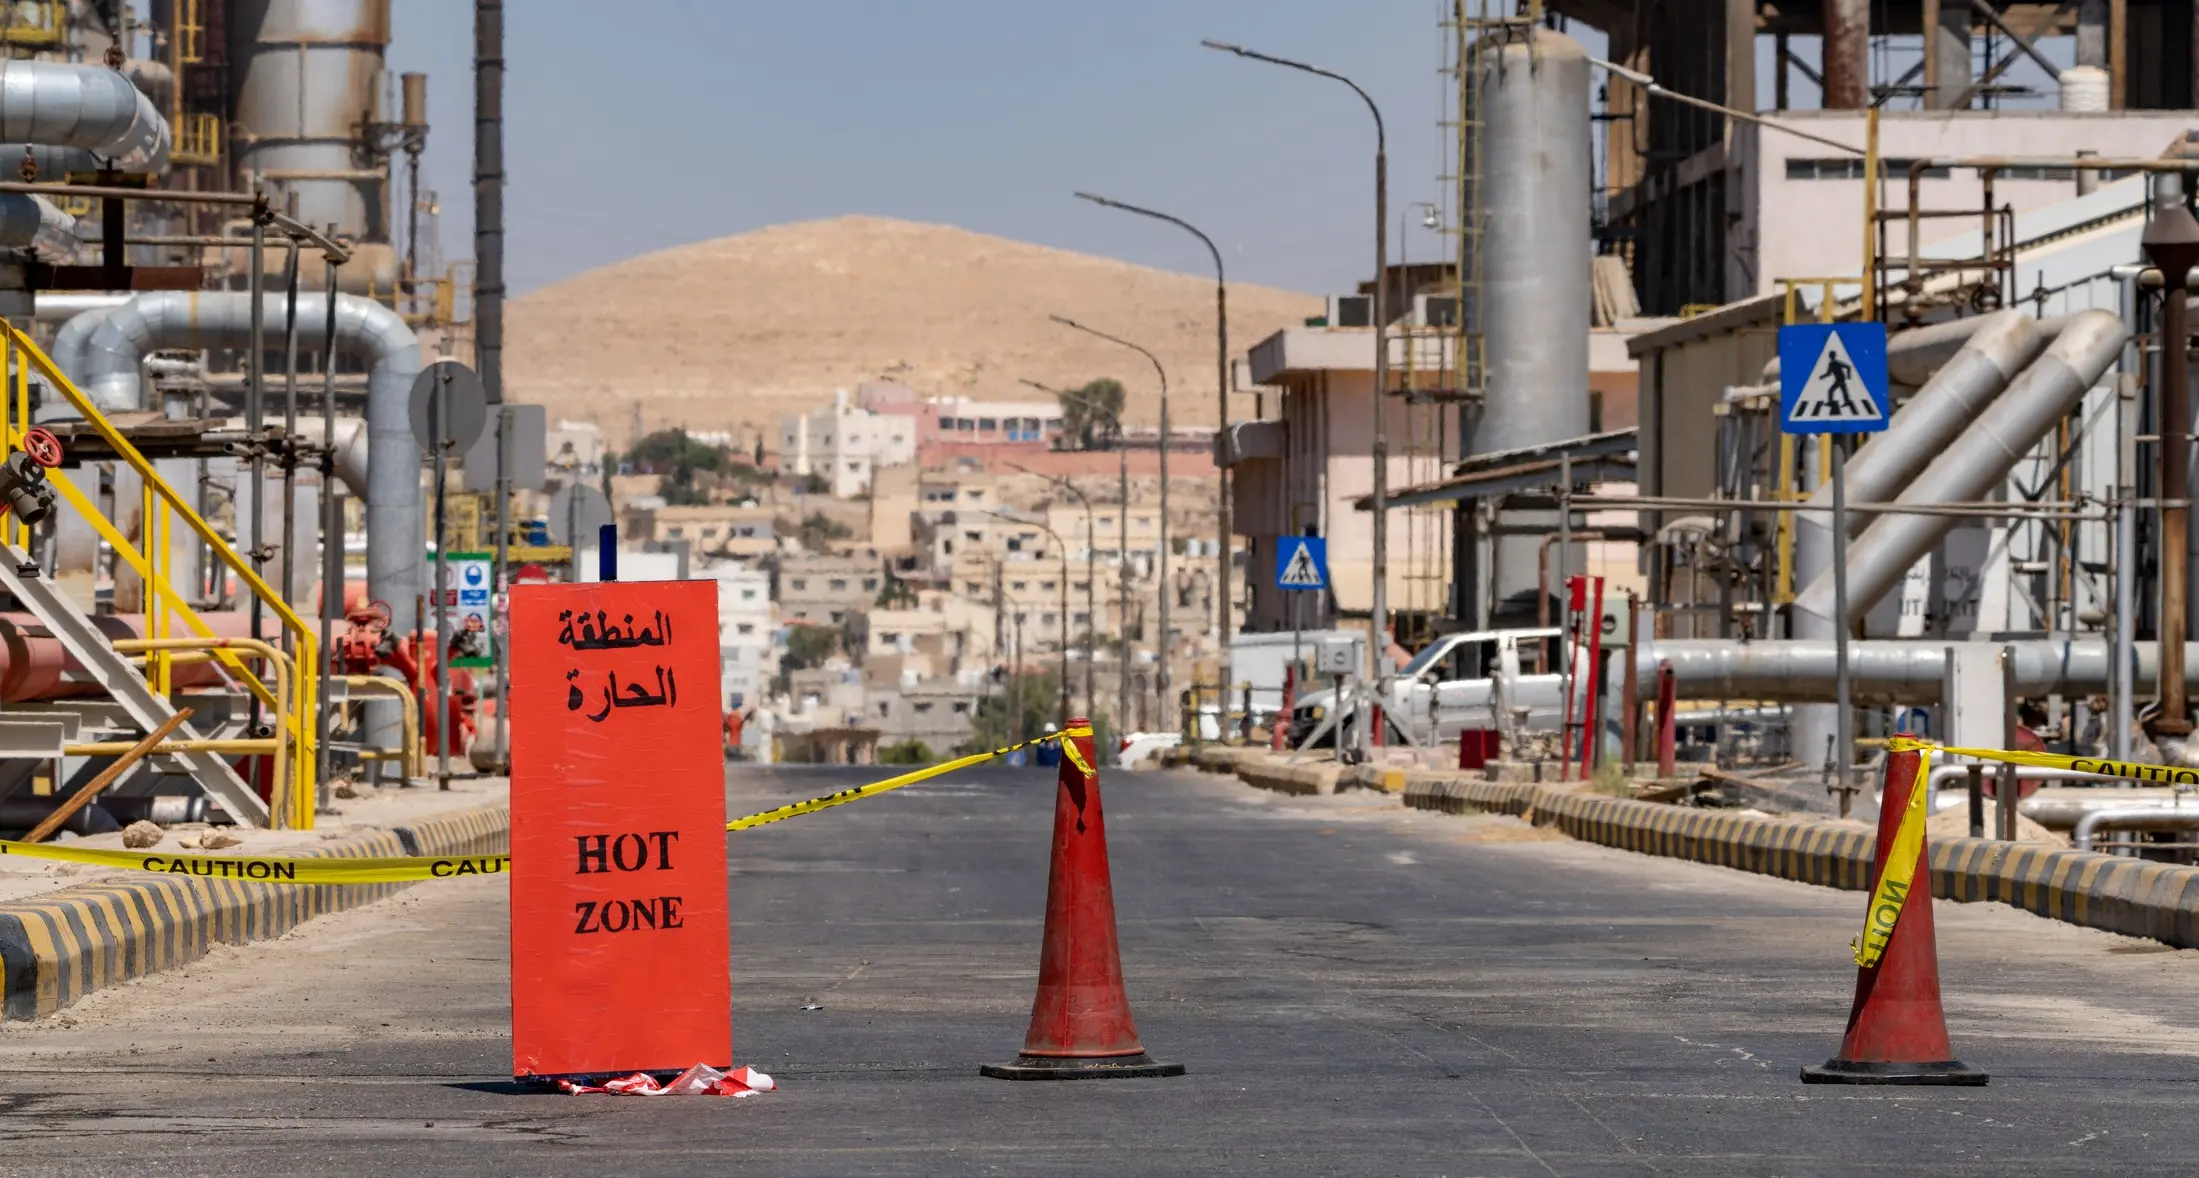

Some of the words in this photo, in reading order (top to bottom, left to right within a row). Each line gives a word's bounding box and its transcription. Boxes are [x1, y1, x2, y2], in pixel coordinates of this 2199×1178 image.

[558, 609, 672, 651] المنطقة
[566, 664, 676, 723] الحارة
[143, 857, 295, 880] CAUTION
[573, 831, 679, 875] HOT
[574, 896, 684, 934] ZONE
